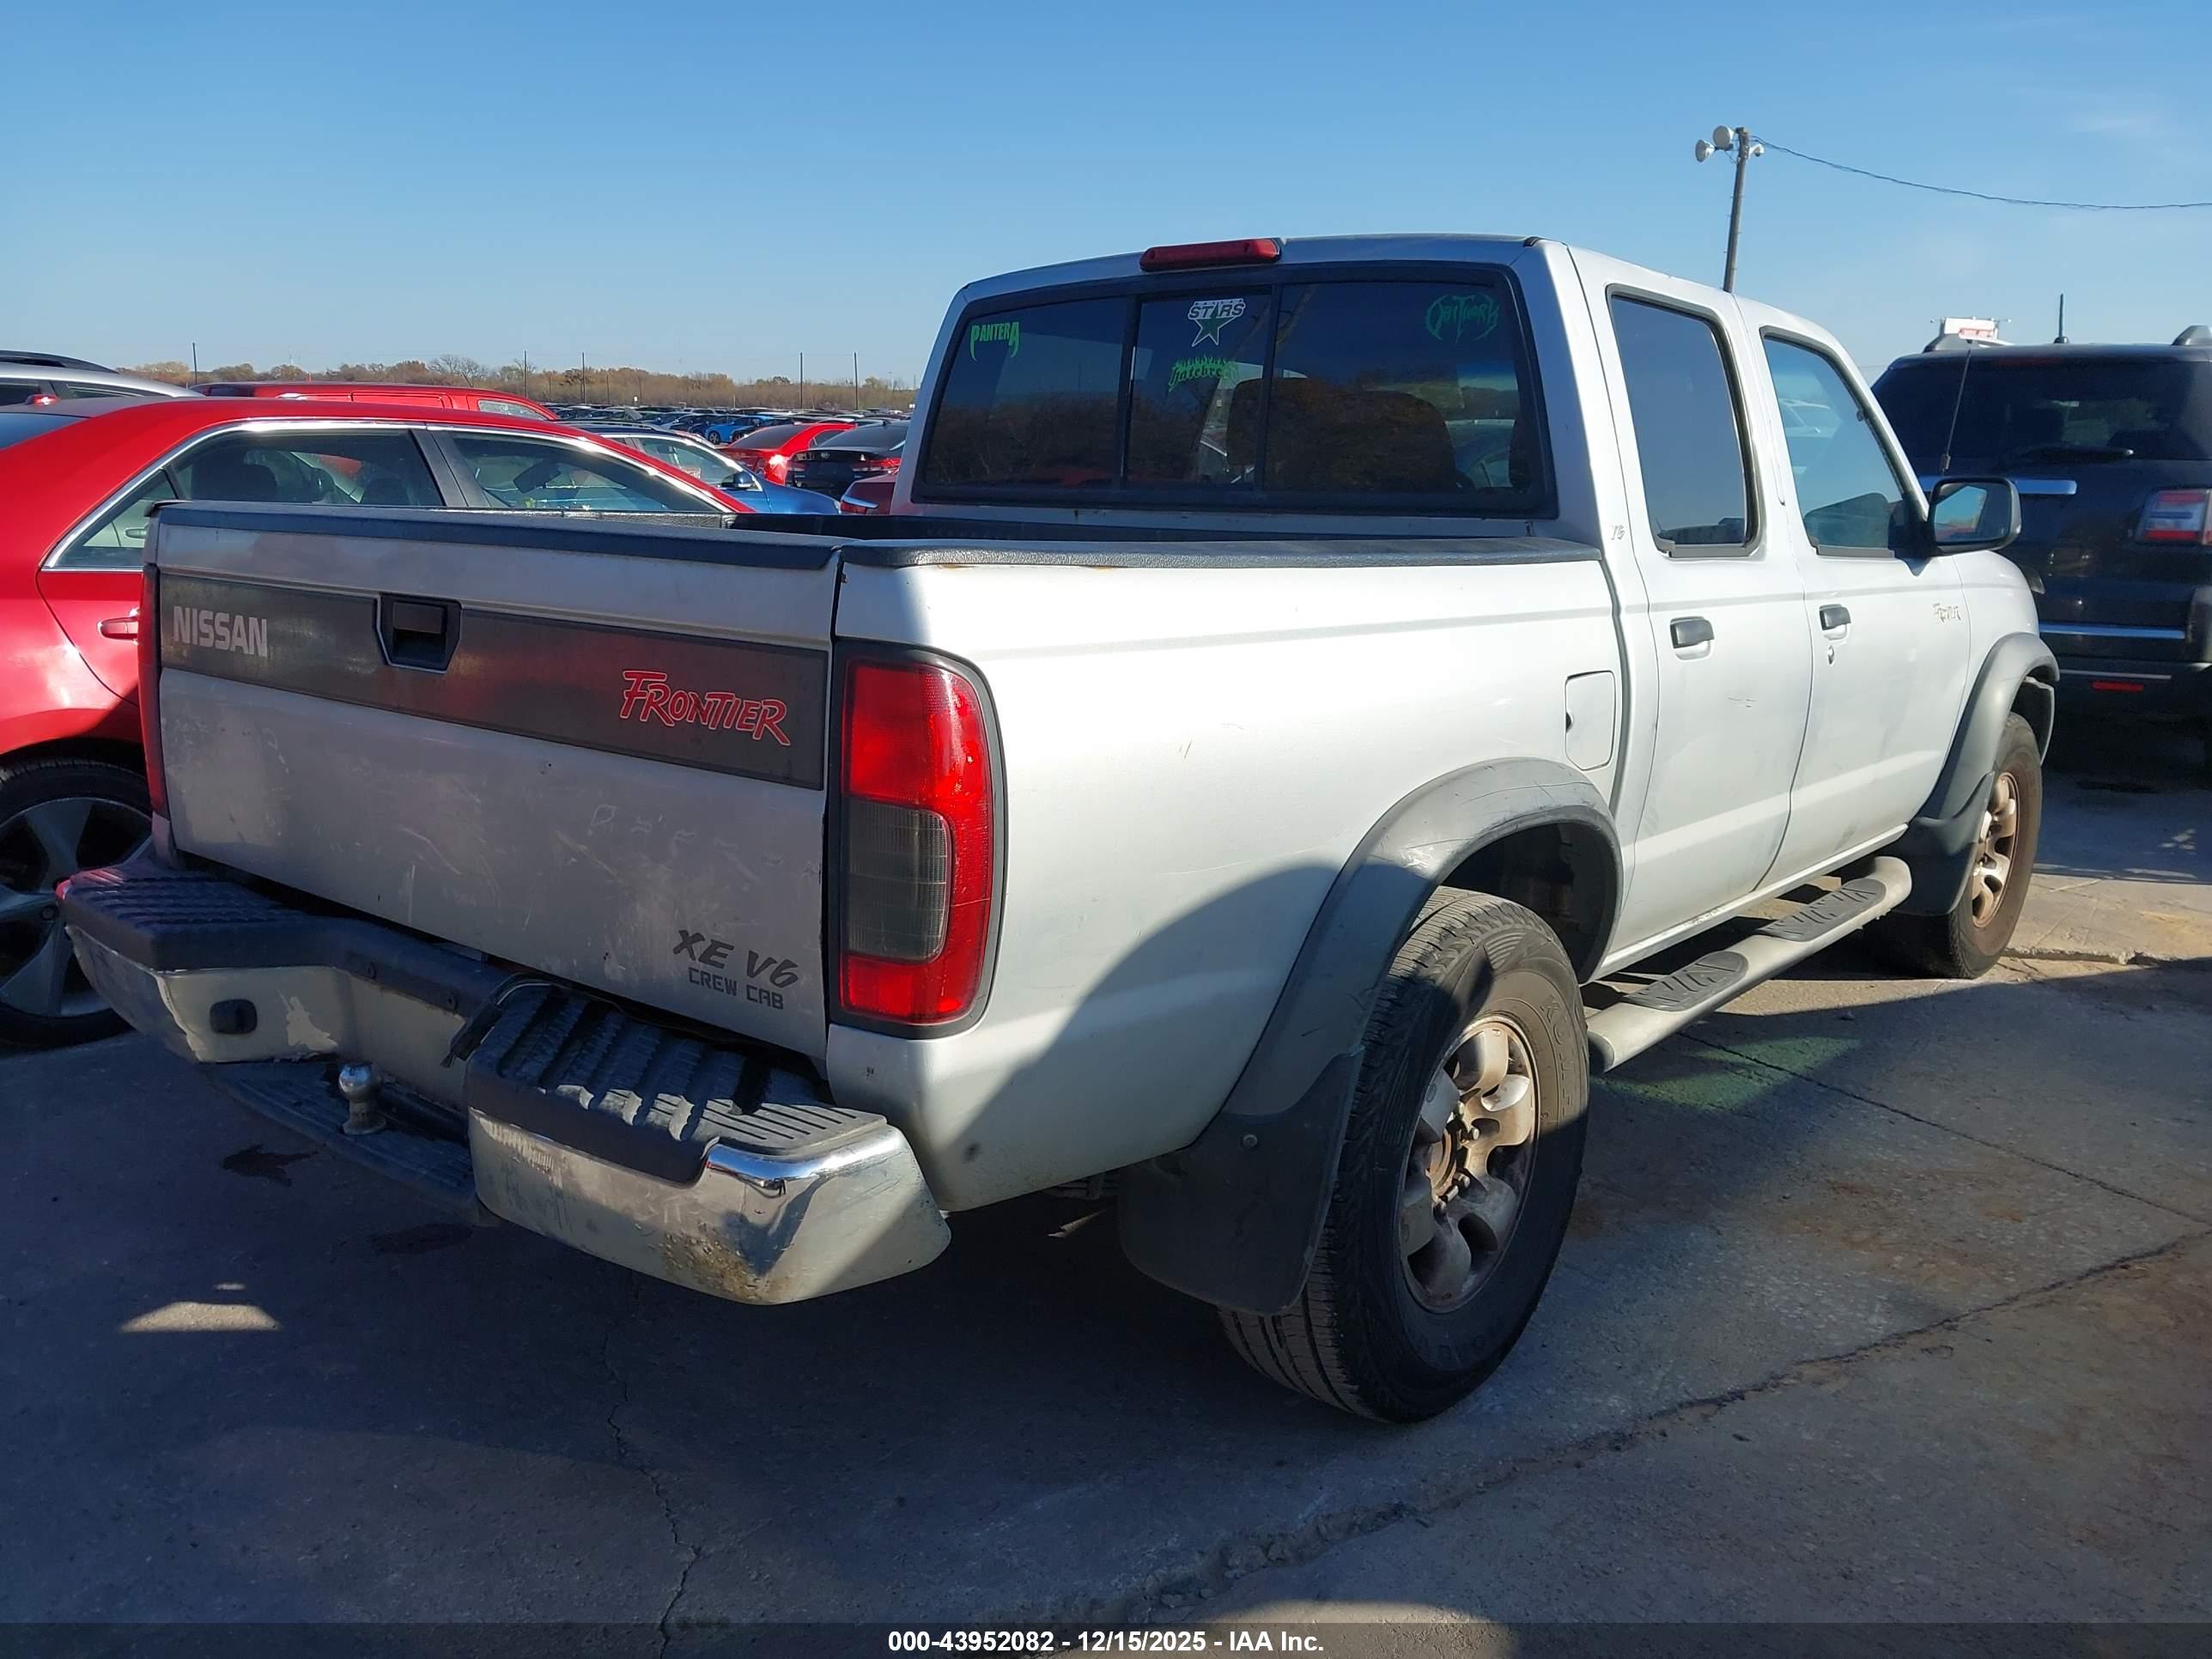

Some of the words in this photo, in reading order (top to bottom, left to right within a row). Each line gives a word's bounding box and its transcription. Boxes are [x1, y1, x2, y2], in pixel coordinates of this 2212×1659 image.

[1188, 301, 1246, 319] STARS
[969, 322, 1019, 362] PANTERA
[173, 605, 268, 658] NISSAN
[673, 929, 735, 969] XE
[746, 950, 799, 988] V6
[688, 967, 738, 996] CREW
[745, 984, 784, 1010] CAB
